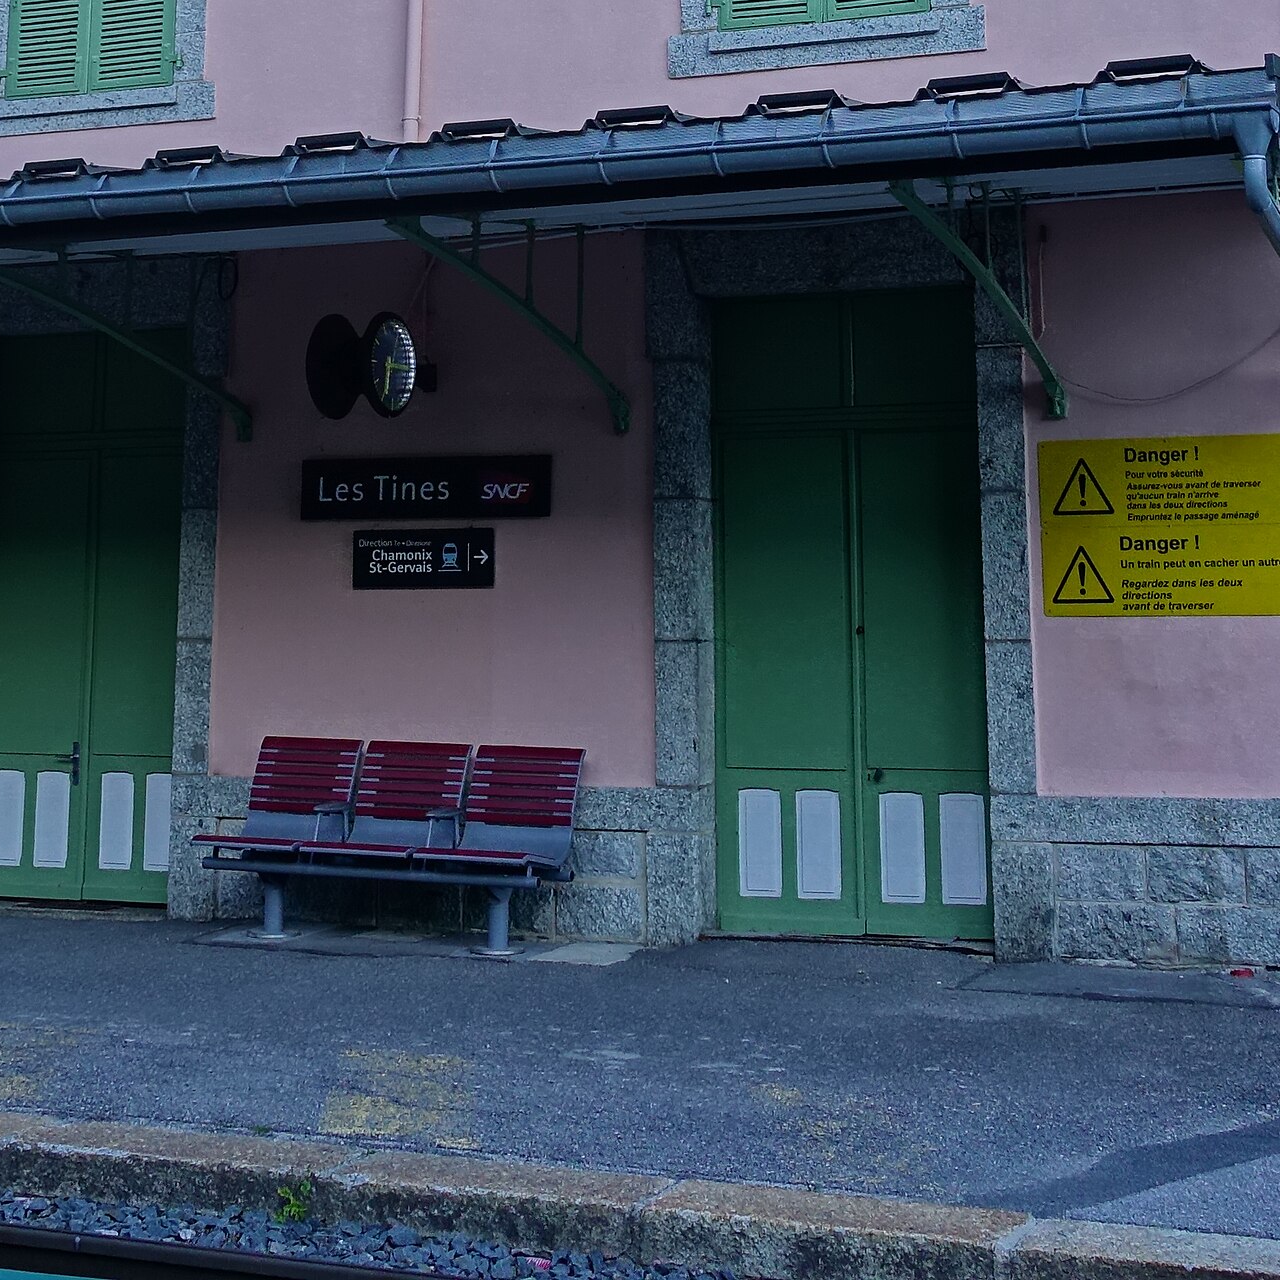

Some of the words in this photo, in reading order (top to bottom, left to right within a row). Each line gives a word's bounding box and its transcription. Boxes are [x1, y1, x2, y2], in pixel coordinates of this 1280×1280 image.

[1124, 447, 1188, 465] Danger
[1194, 446, 1199, 460] !
[1125, 470, 1145, 479] Pour
[1147, 469, 1168, 478] votre
[1170, 467, 1204, 478] sécurité
[319, 476, 364, 502] Les
[373, 474, 450, 501] Tines
[481, 482, 530, 500] SNCF
[1126, 482, 1183, 491] Assurez-vous
[1185, 481, 1209, 489] avant
[1210, 481, 1221, 489] de
[1223, 480, 1262, 488] traverser
[1126, 492, 1165, 501] qu'aucun
[1166, 491, 1186, 499] train
[1187, 491, 1219, 499] n'arrive
[1126, 502, 1147, 510] dans
[1149, 501, 1161, 509] les
[1163, 501, 1184, 509] deux
[1186, 500, 1228, 509] directions
[1127, 512, 1173, 523] Empruntez
[1174, 512, 1182, 521] le
[1184, 513, 1219, 522] passage
[1221, 510, 1260, 521] aménagé
[358, 538, 393, 548] Direction
[1119, 536, 1188, 554] Danger
[1194, 534, 1200, 549] !
[372, 548, 433, 561] Chamonix
[369, 561, 433, 574] St-Gervais
[1120, 559, 1135, 569] Un
[1137, 559, 1161, 569] train
[1163, 559, 1186, 570] peut
[1188, 560, 1201, 568] en
[1204, 557, 1239, 567] cacher
[1242, 559, 1255, 567] un
[1121, 579, 1169, 590] Regardez
[1172, 578, 1196, 588] dans
[1199, 578, 1215, 587] les
[1217, 578, 1243, 587] deux
[1122, 590, 1173, 600] directions
[1122, 601, 1151, 611] avant
[1153, 600, 1166, 610] de
[1168, 601, 1215, 610] traverser
